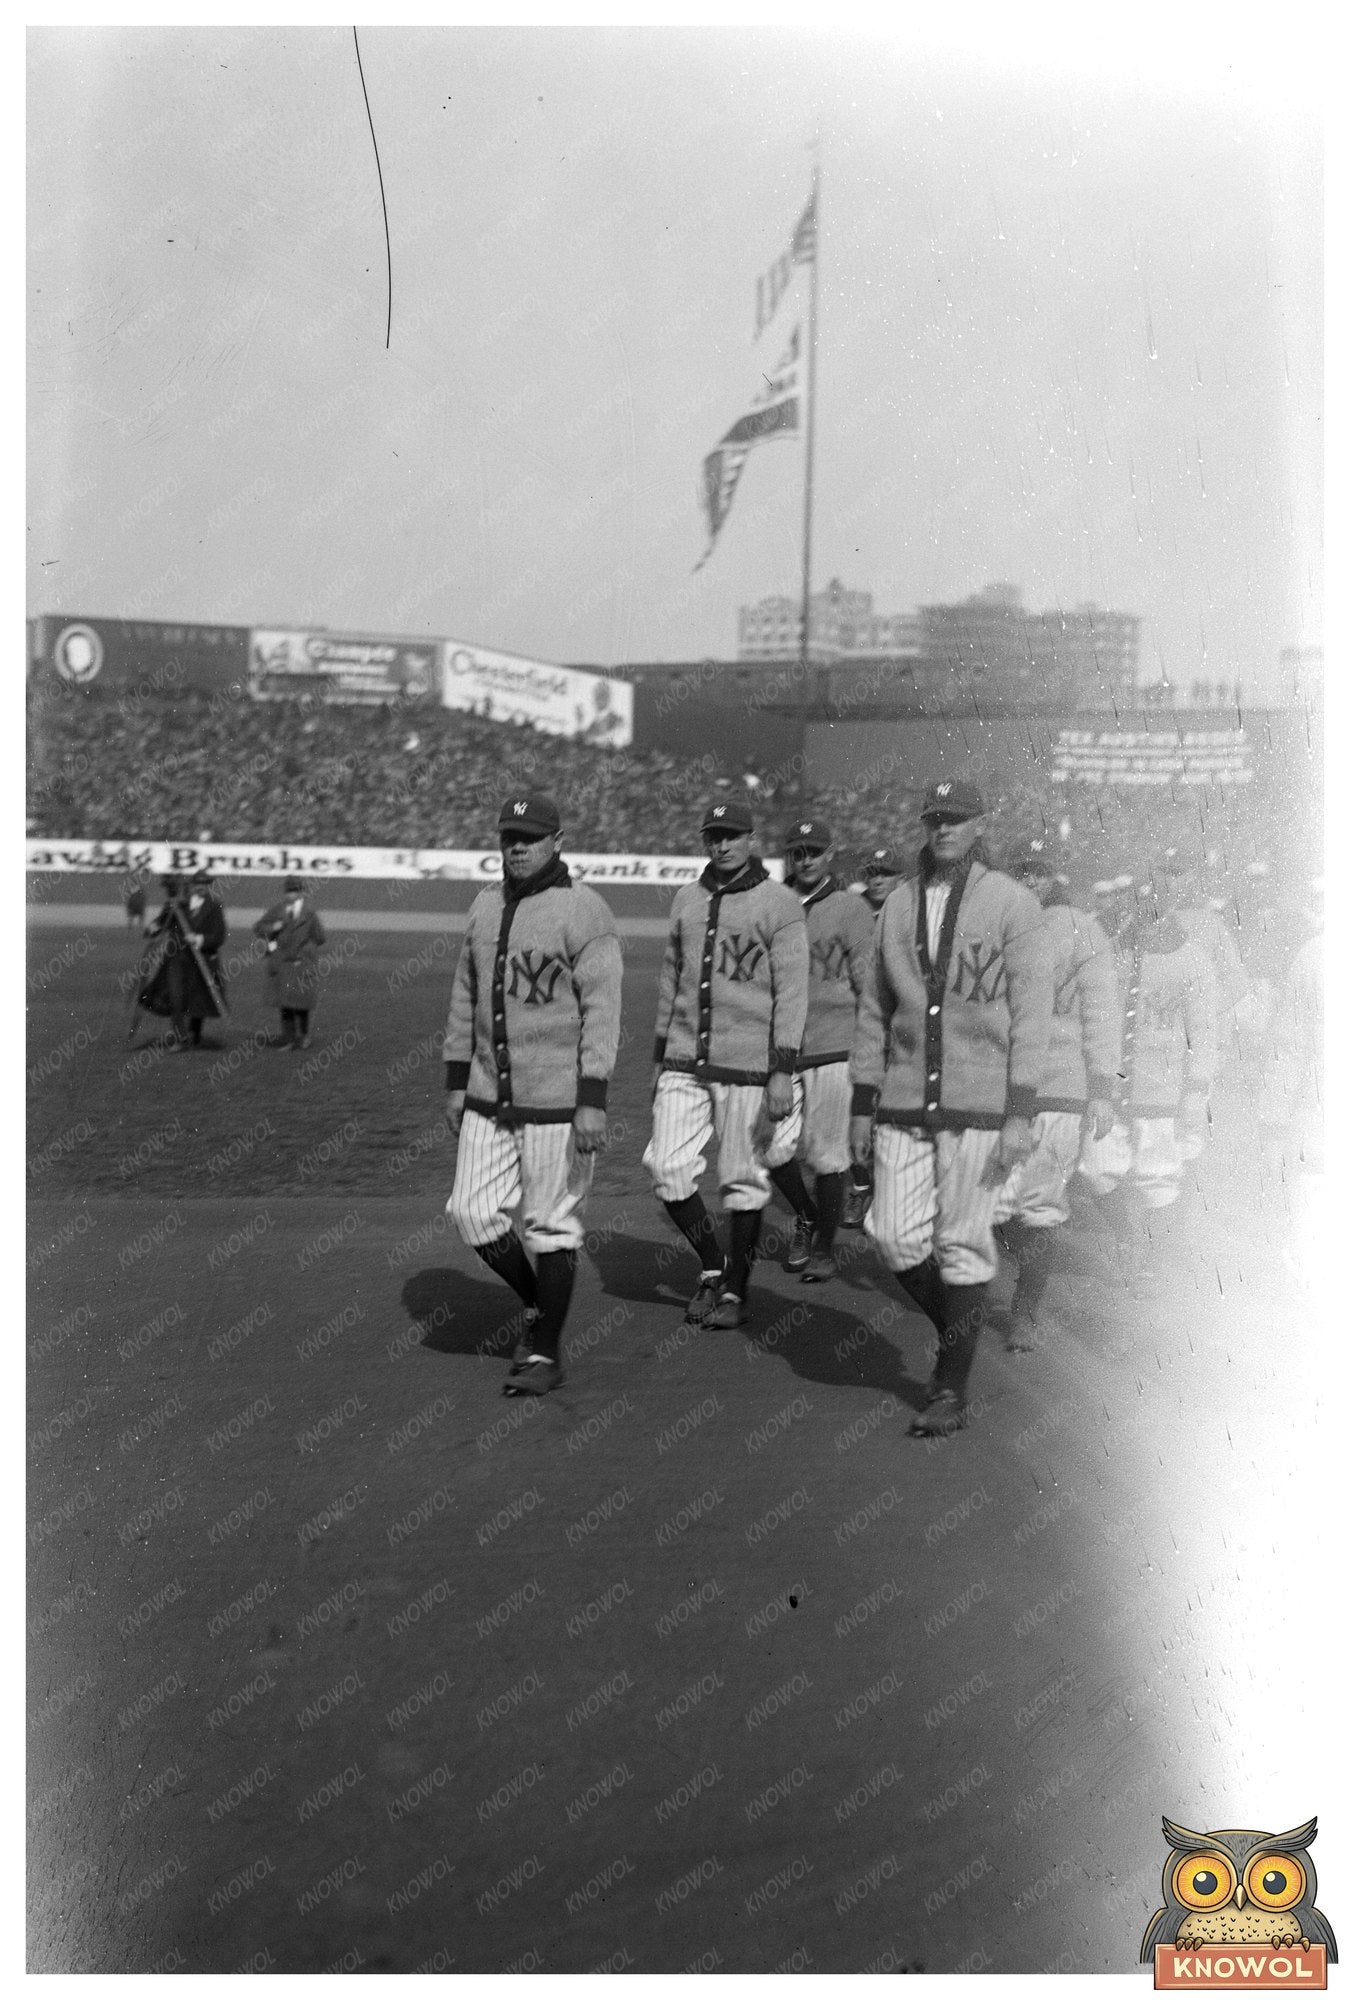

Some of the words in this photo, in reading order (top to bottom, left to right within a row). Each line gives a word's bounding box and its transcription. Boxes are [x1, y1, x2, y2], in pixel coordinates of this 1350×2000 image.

[170, 849, 354, 872] Brushes
[507, 949, 573, 1004] NY
[715, 921, 772, 982] NY
